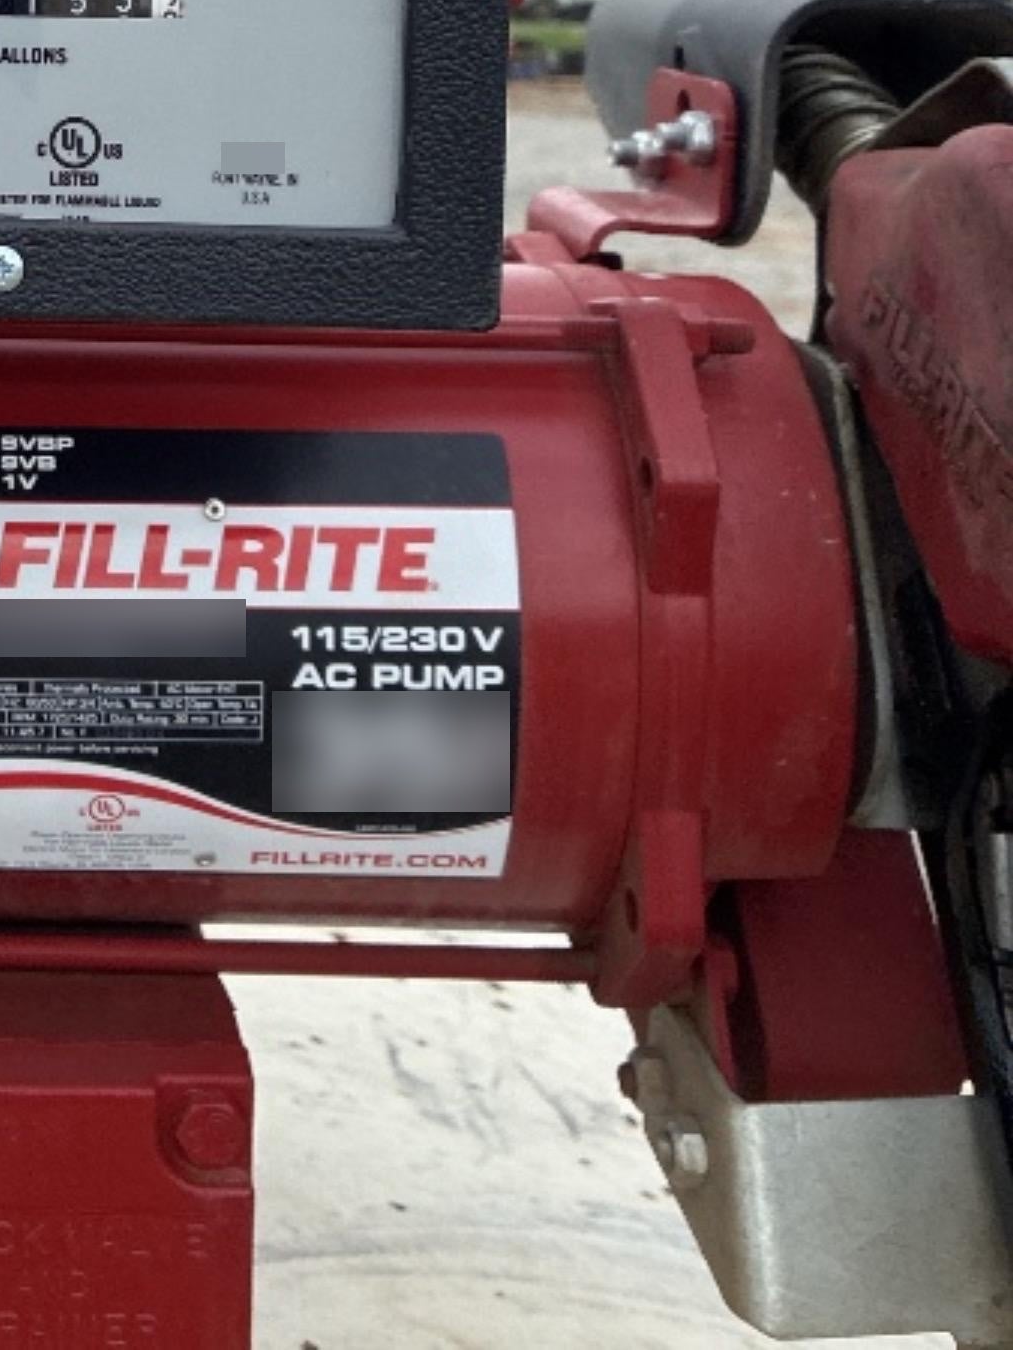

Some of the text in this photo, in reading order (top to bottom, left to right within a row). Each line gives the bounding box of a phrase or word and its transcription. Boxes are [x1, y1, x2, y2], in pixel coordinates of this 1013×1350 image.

[103, 143, 123, 160] US
[49, 171, 99, 187] LISTED
[291, 625, 505, 654] 115/230 V
[291, 662, 506, 691] AC PUMP
[251, 851, 487, 869] FILLRITE.COM
